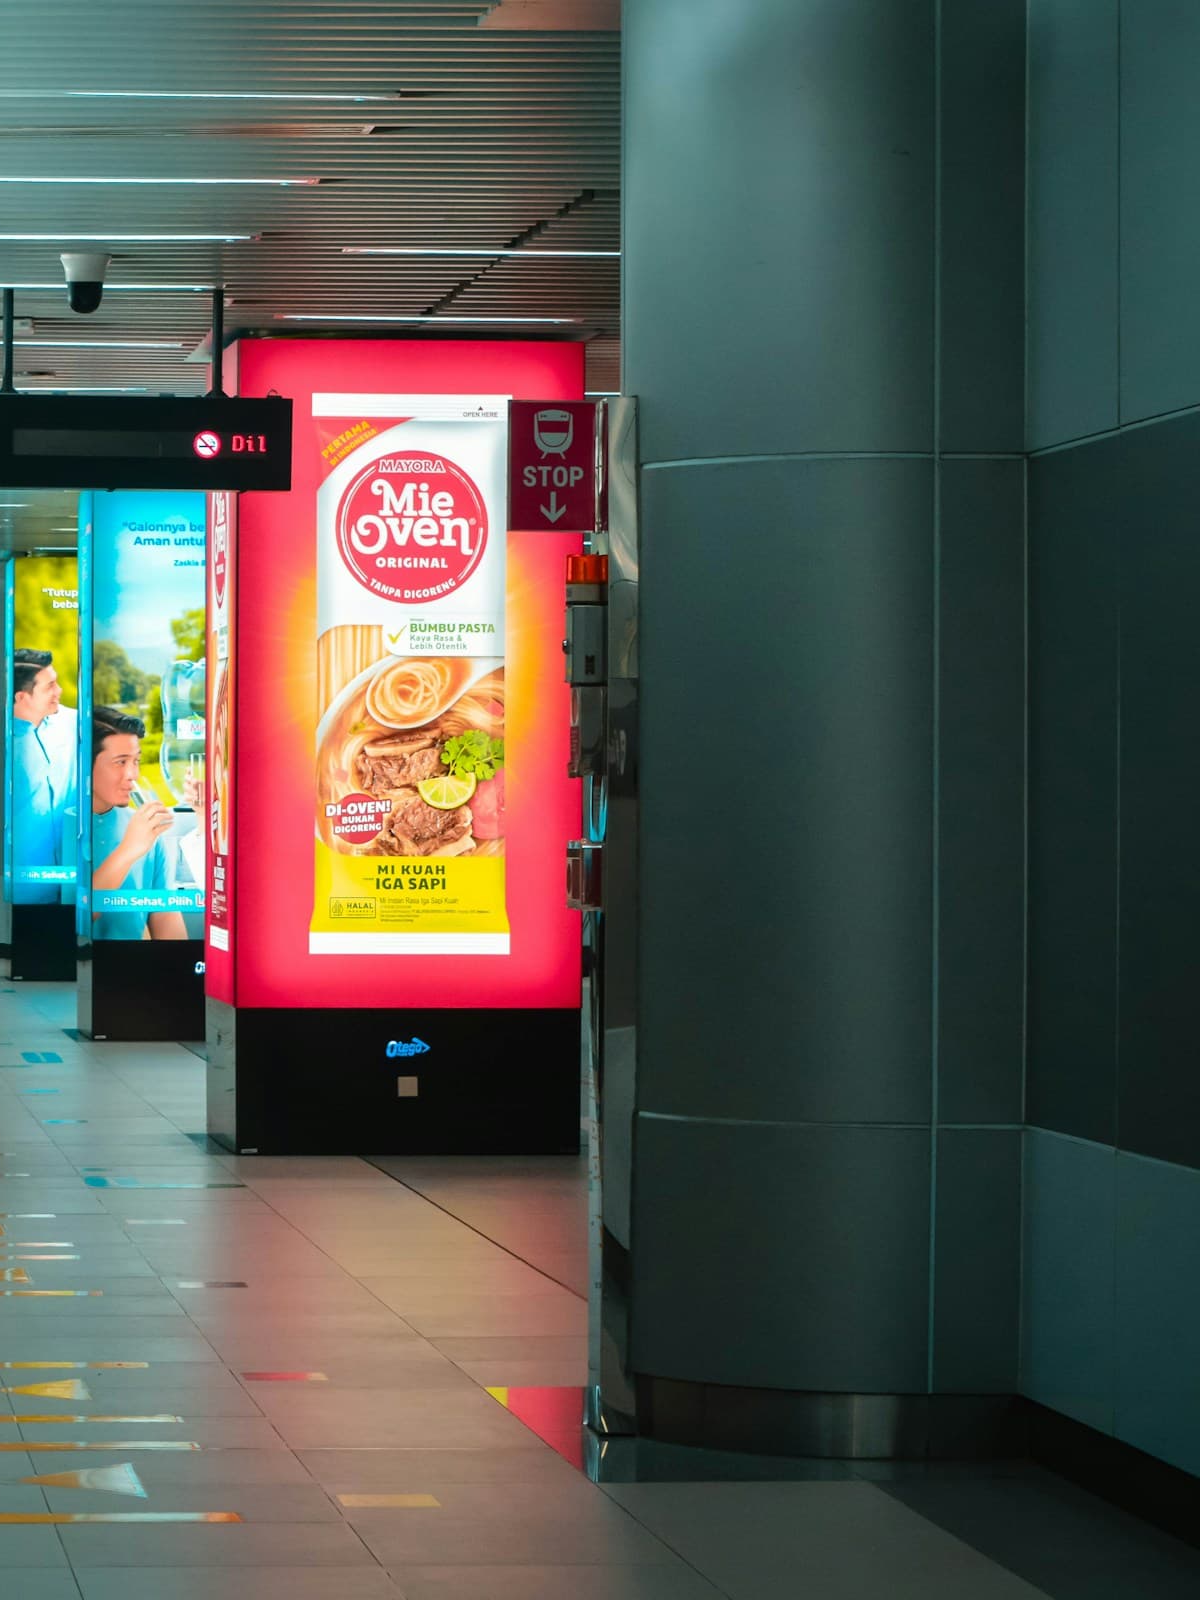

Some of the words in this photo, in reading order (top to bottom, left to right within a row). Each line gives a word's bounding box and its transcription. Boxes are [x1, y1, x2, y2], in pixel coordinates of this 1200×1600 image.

[232, 435, 267, 452] Dil
[321, 420, 370, 459] PERTAMA
[379, 460, 446, 473] MAYORA
[523, 466, 584, 488] STOP
[371, 479, 454, 517] Mie
[134, 536, 170, 546] Aman
[350, 514, 474, 555] Oven
[375, 557, 448, 569] ORIGINAL
[370, 578, 401, 598] TANPA
[404, 577, 457, 599] DIGORENG
[410, 623, 456, 633] BUMBU
[458, 623, 495, 633] PASTA
[410, 634, 431, 642] Kaya
[434, 634, 454, 642] Rasa
[325, 799, 392, 817] DI-OVEN!
[341, 814, 375, 825] BUKAN
[334, 823, 383, 834] DIGORENG
[378, 865, 395, 875] MI
[401, 865, 446, 875] KUAH
[376, 878, 404, 890] IGA
[408, 878, 447, 890] SAPI
[103, 894, 128, 906] Pilih
[130, 895, 165, 907] Sehat,
[168, 894, 193, 906] Pilih
